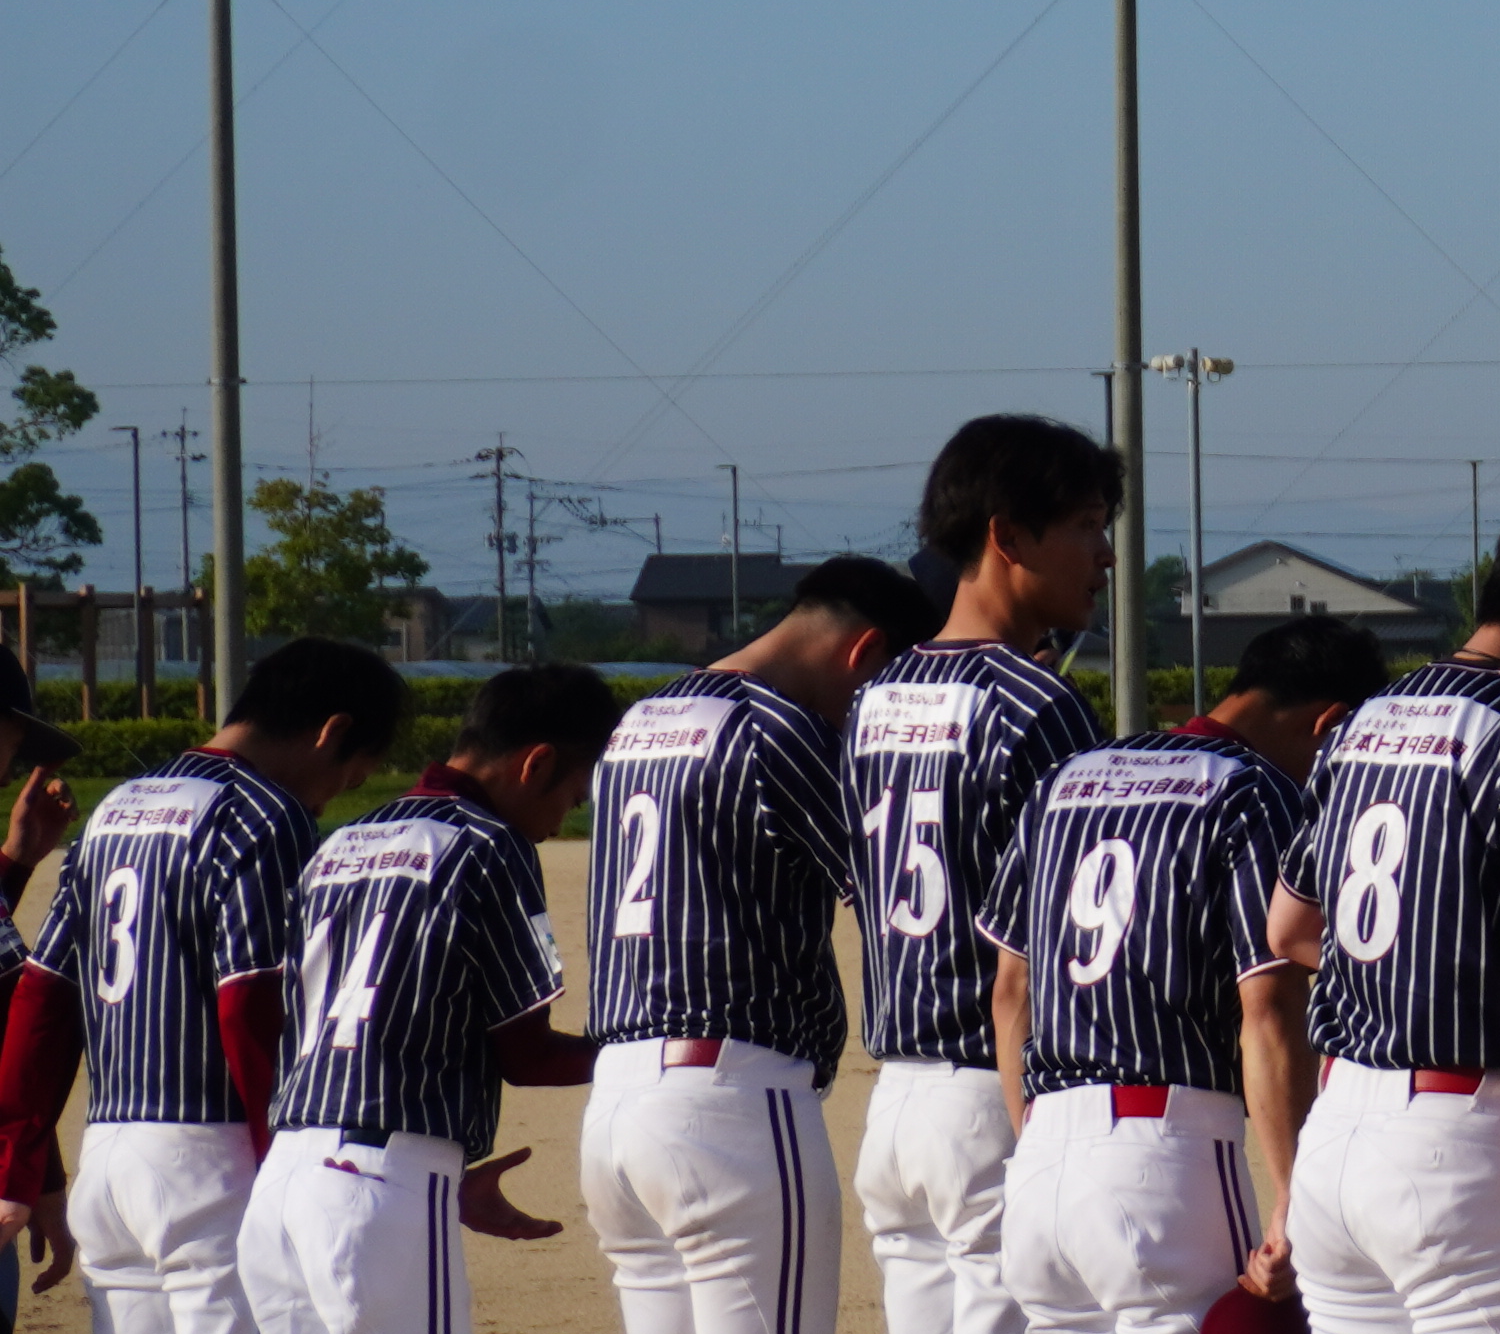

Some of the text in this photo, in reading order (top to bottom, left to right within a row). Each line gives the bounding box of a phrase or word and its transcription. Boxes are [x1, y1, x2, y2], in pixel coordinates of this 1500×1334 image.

[96, 867, 140, 1005] 3
[614, 792, 661, 939] 2
[861, 787, 950, 938] 15
[1066, 839, 1138, 986] 9
[1336, 800, 1406, 963] 8
